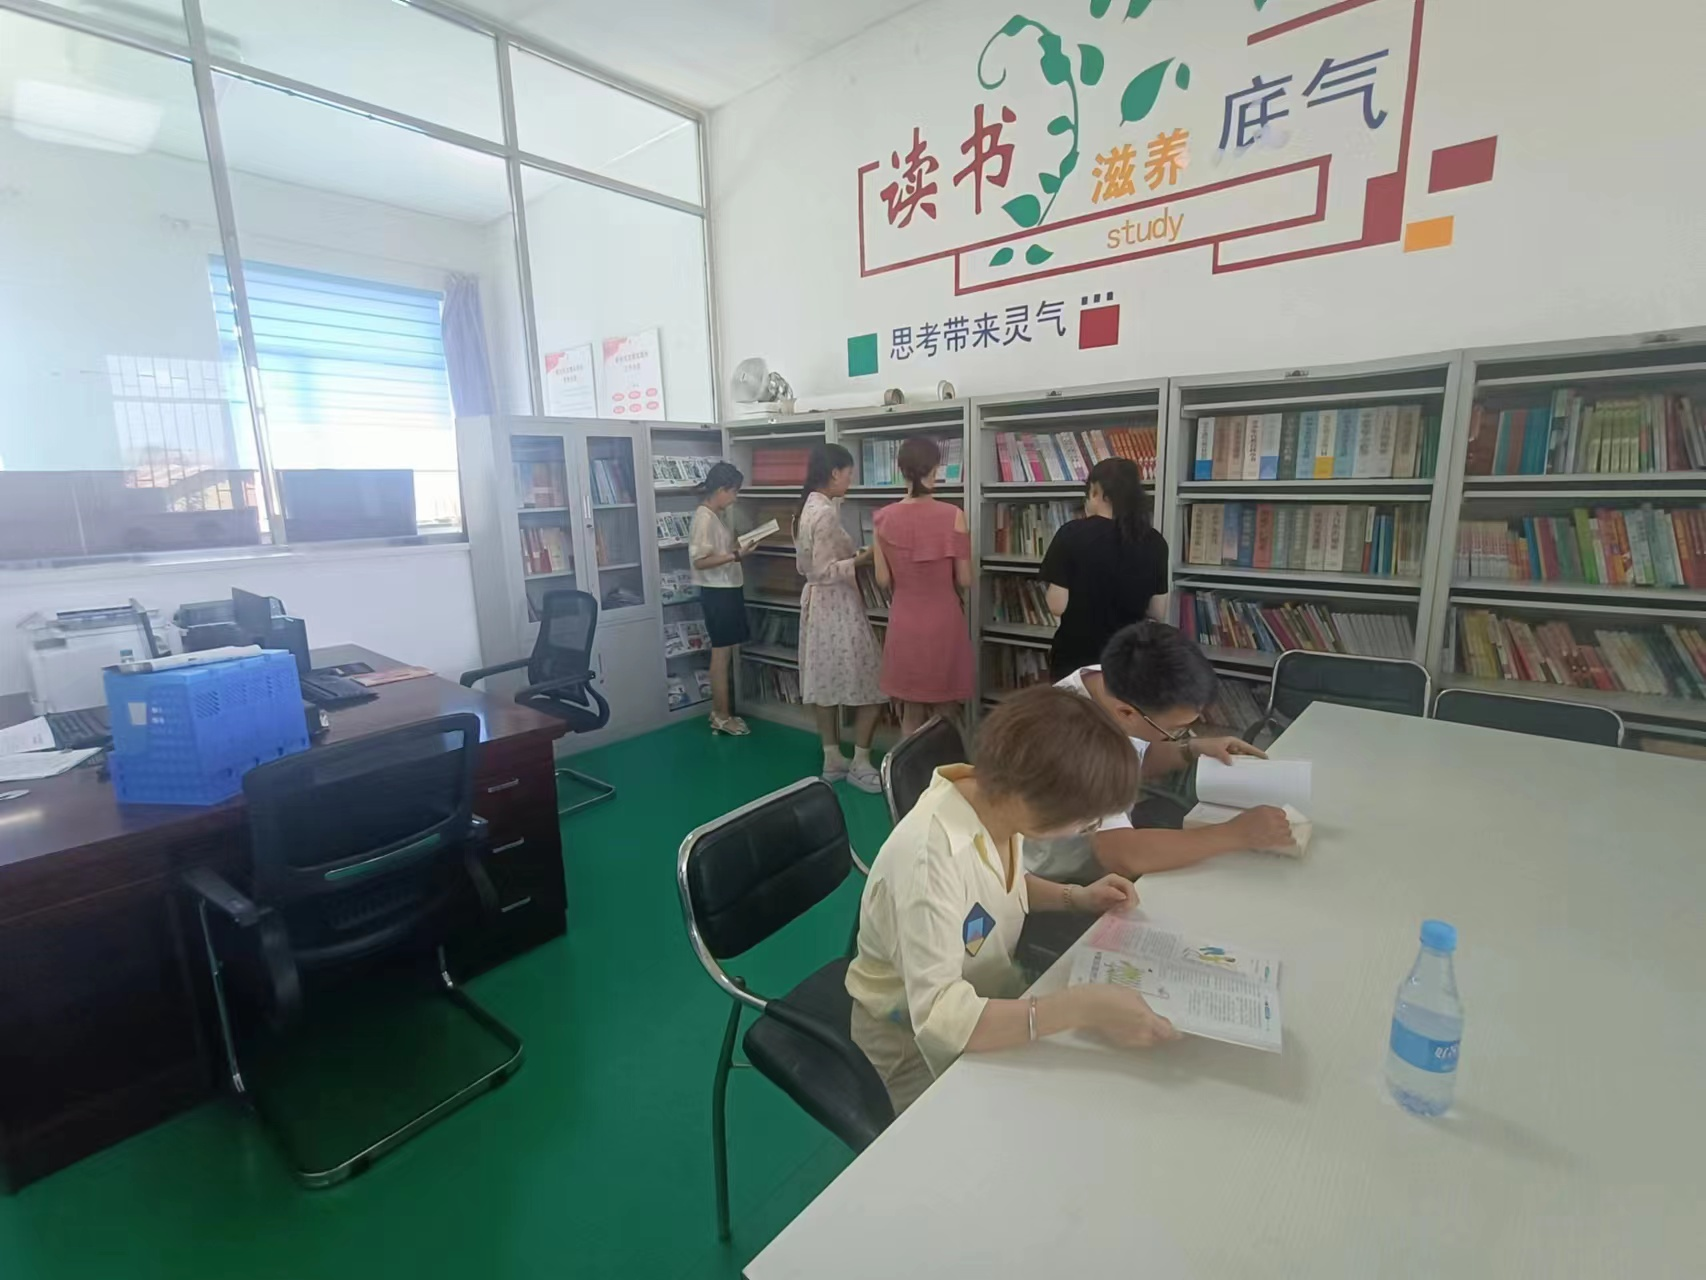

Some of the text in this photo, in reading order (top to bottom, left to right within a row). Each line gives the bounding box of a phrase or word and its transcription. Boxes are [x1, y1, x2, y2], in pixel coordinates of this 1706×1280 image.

[880, 48, 1390, 229] 读书 滋养 底气
[1107, 206, 1185, 249] study
[889, 300, 1067, 361] 思考带来灵气
